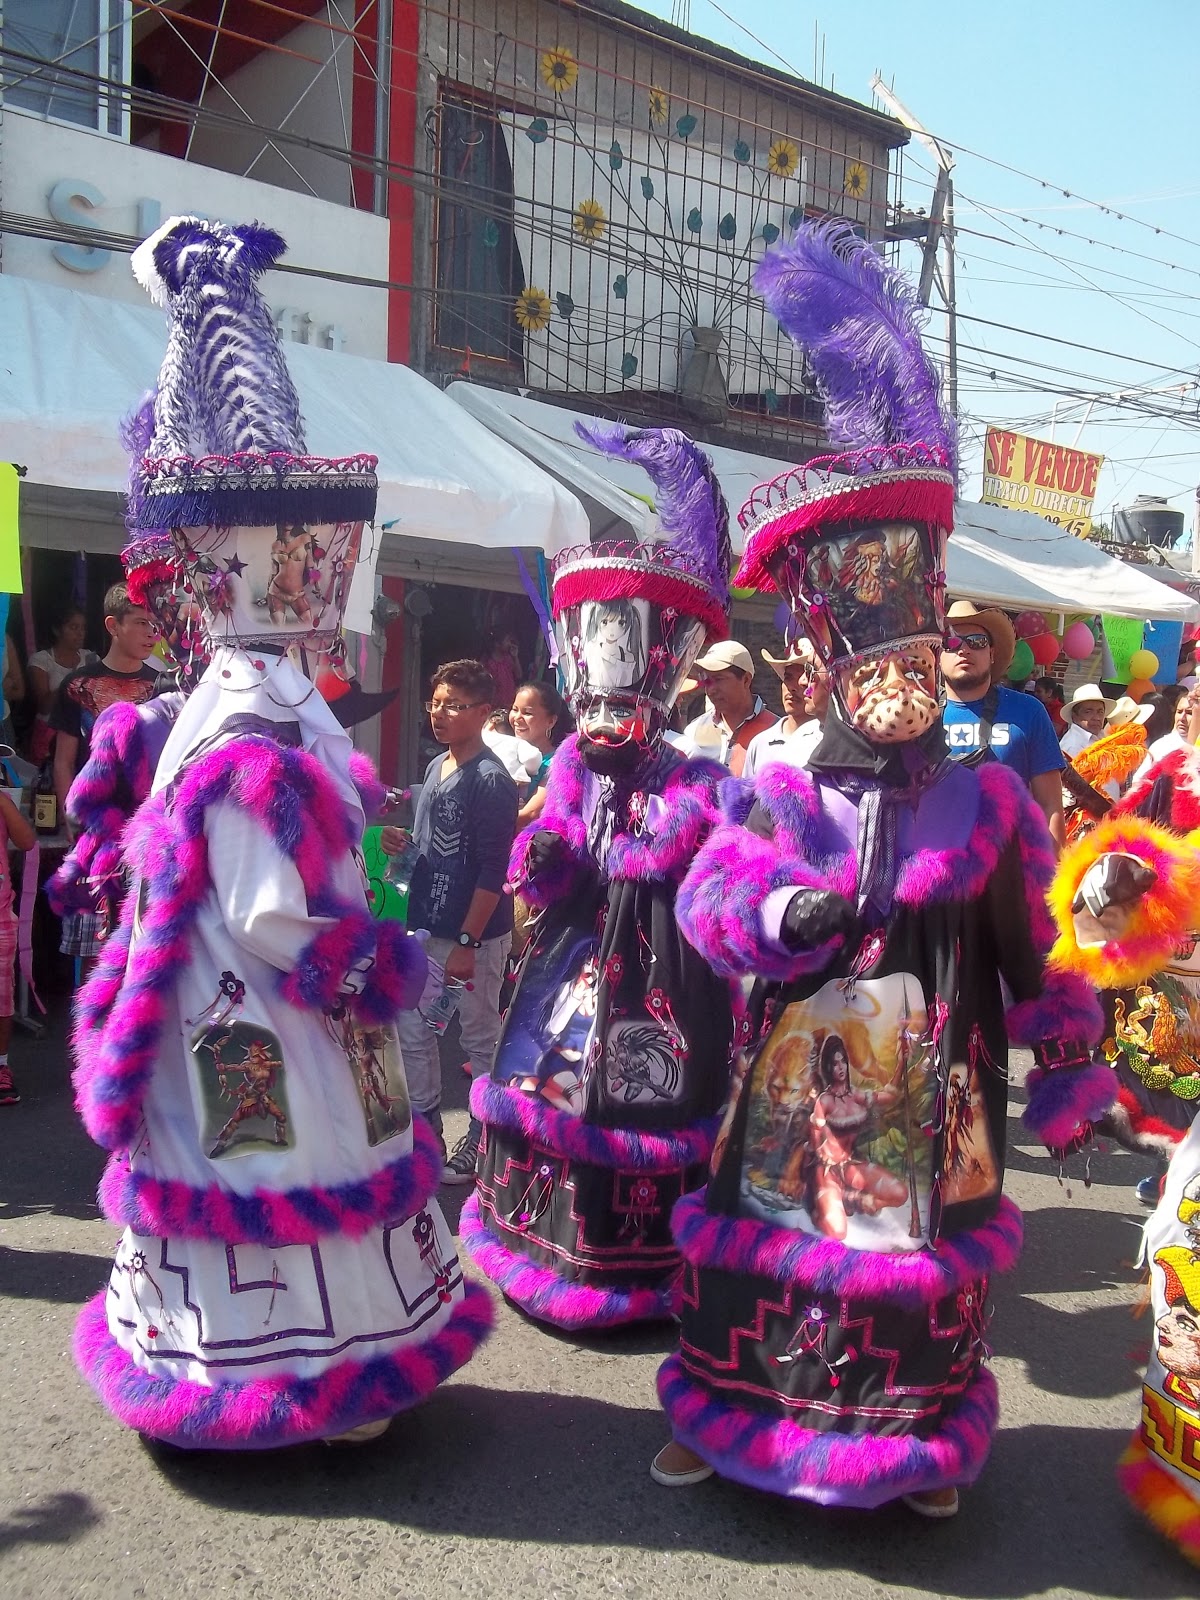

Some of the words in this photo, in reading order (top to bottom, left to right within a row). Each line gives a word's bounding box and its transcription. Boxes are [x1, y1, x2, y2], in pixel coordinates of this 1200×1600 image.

[987, 428, 1017, 478] SE
[1024, 437, 1100, 498] VENDE
[985, 477, 1029, 504] TRATO
[1031, 488, 1094, 518] DIRECTO
